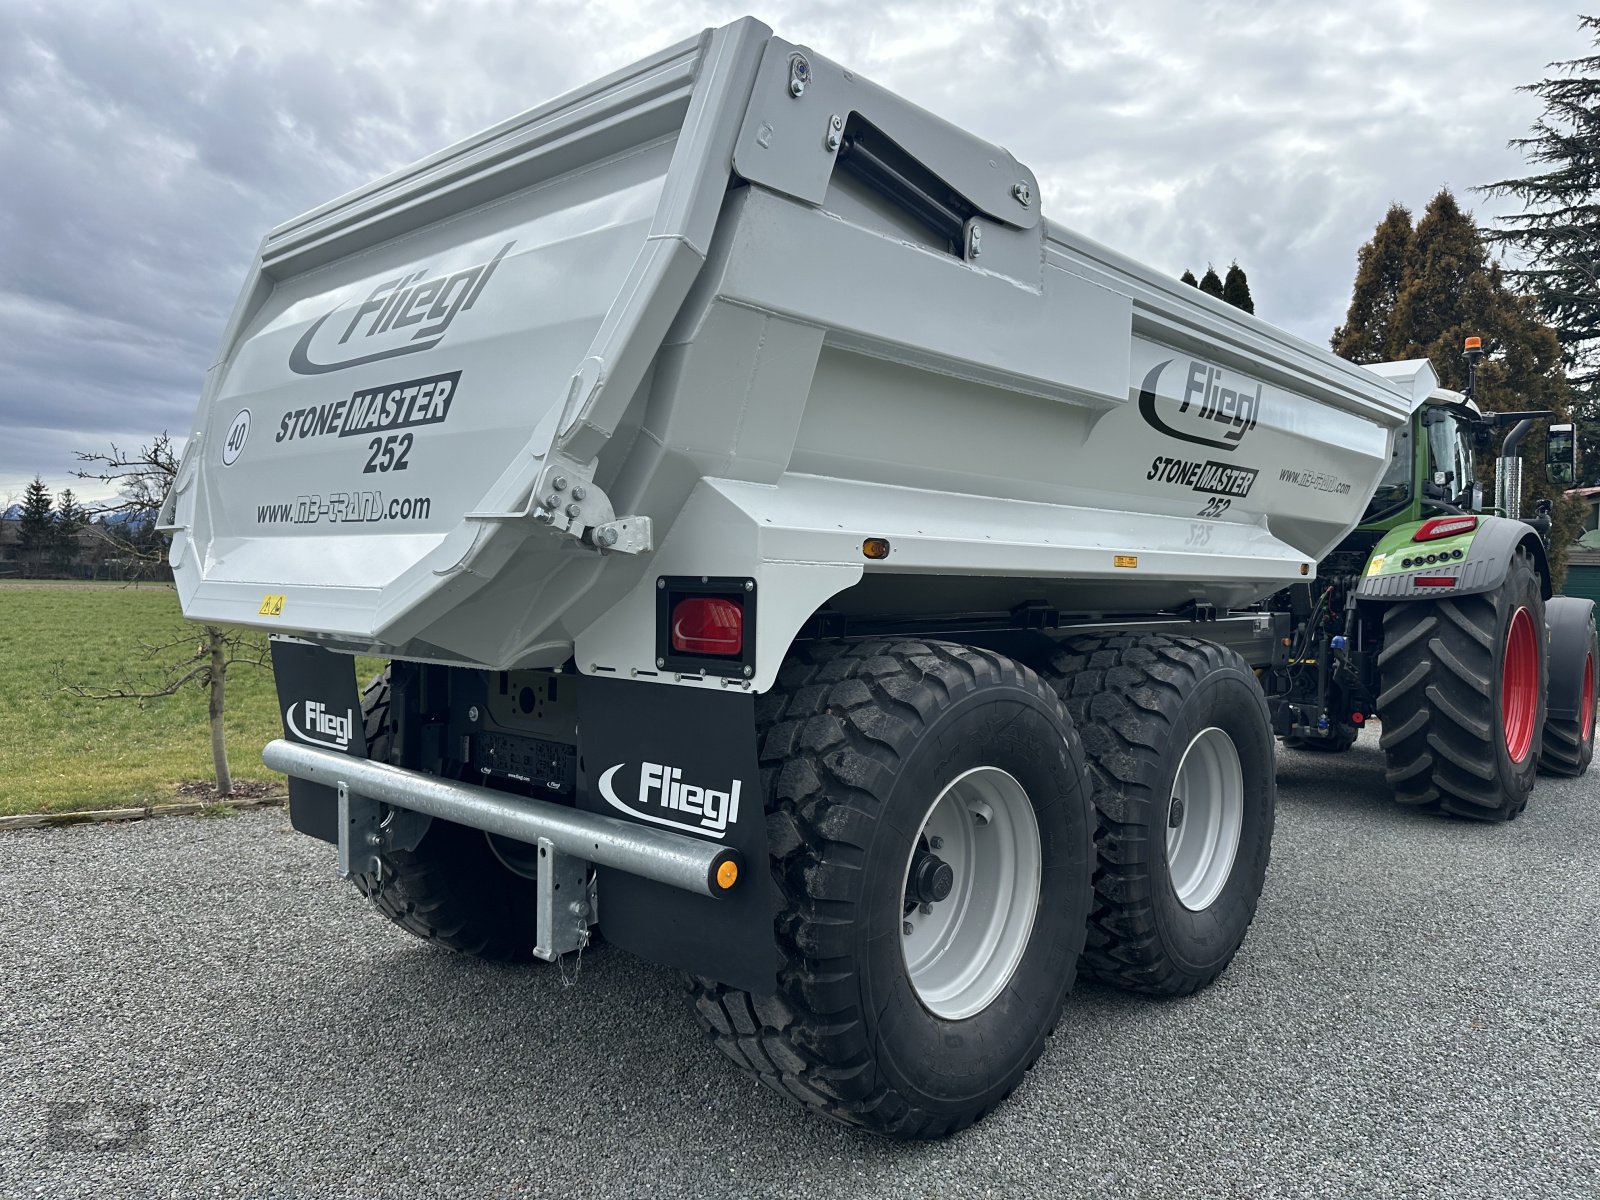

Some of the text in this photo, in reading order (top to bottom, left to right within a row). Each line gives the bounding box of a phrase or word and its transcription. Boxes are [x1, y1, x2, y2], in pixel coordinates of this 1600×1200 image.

[338, 240, 517, 346] Fliegl
[1179, 361, 1262, 441] Fliegl
[227, 422, 246, 452] 40
[362, 432, 414, 474] 252
[1196, 496, 1232, 518] 252
[305, 700, 353, 745] Fliegl
[638, 761, 742, 830] Fliegl
